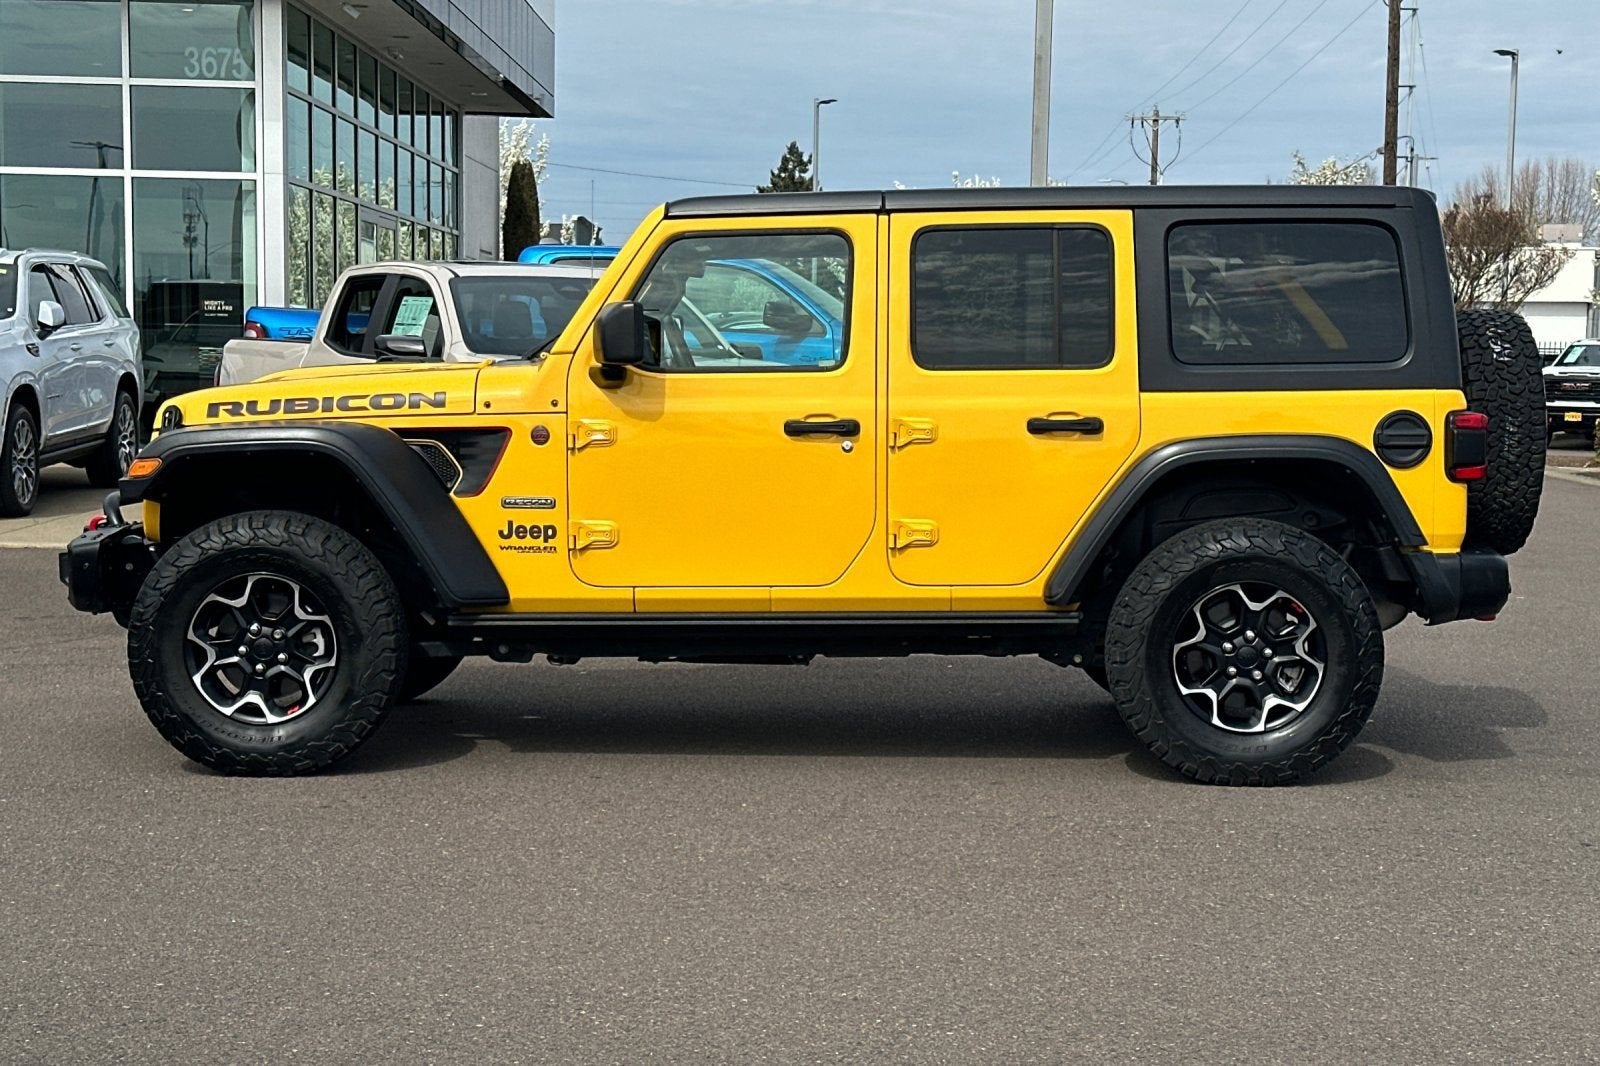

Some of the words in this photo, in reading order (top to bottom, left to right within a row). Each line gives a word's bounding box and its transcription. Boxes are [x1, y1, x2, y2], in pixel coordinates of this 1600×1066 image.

[183, 46, 249, 80] 3675
[206, 392, 447, 418] RUBICON
[498, 520, 557, 543] Jeep
